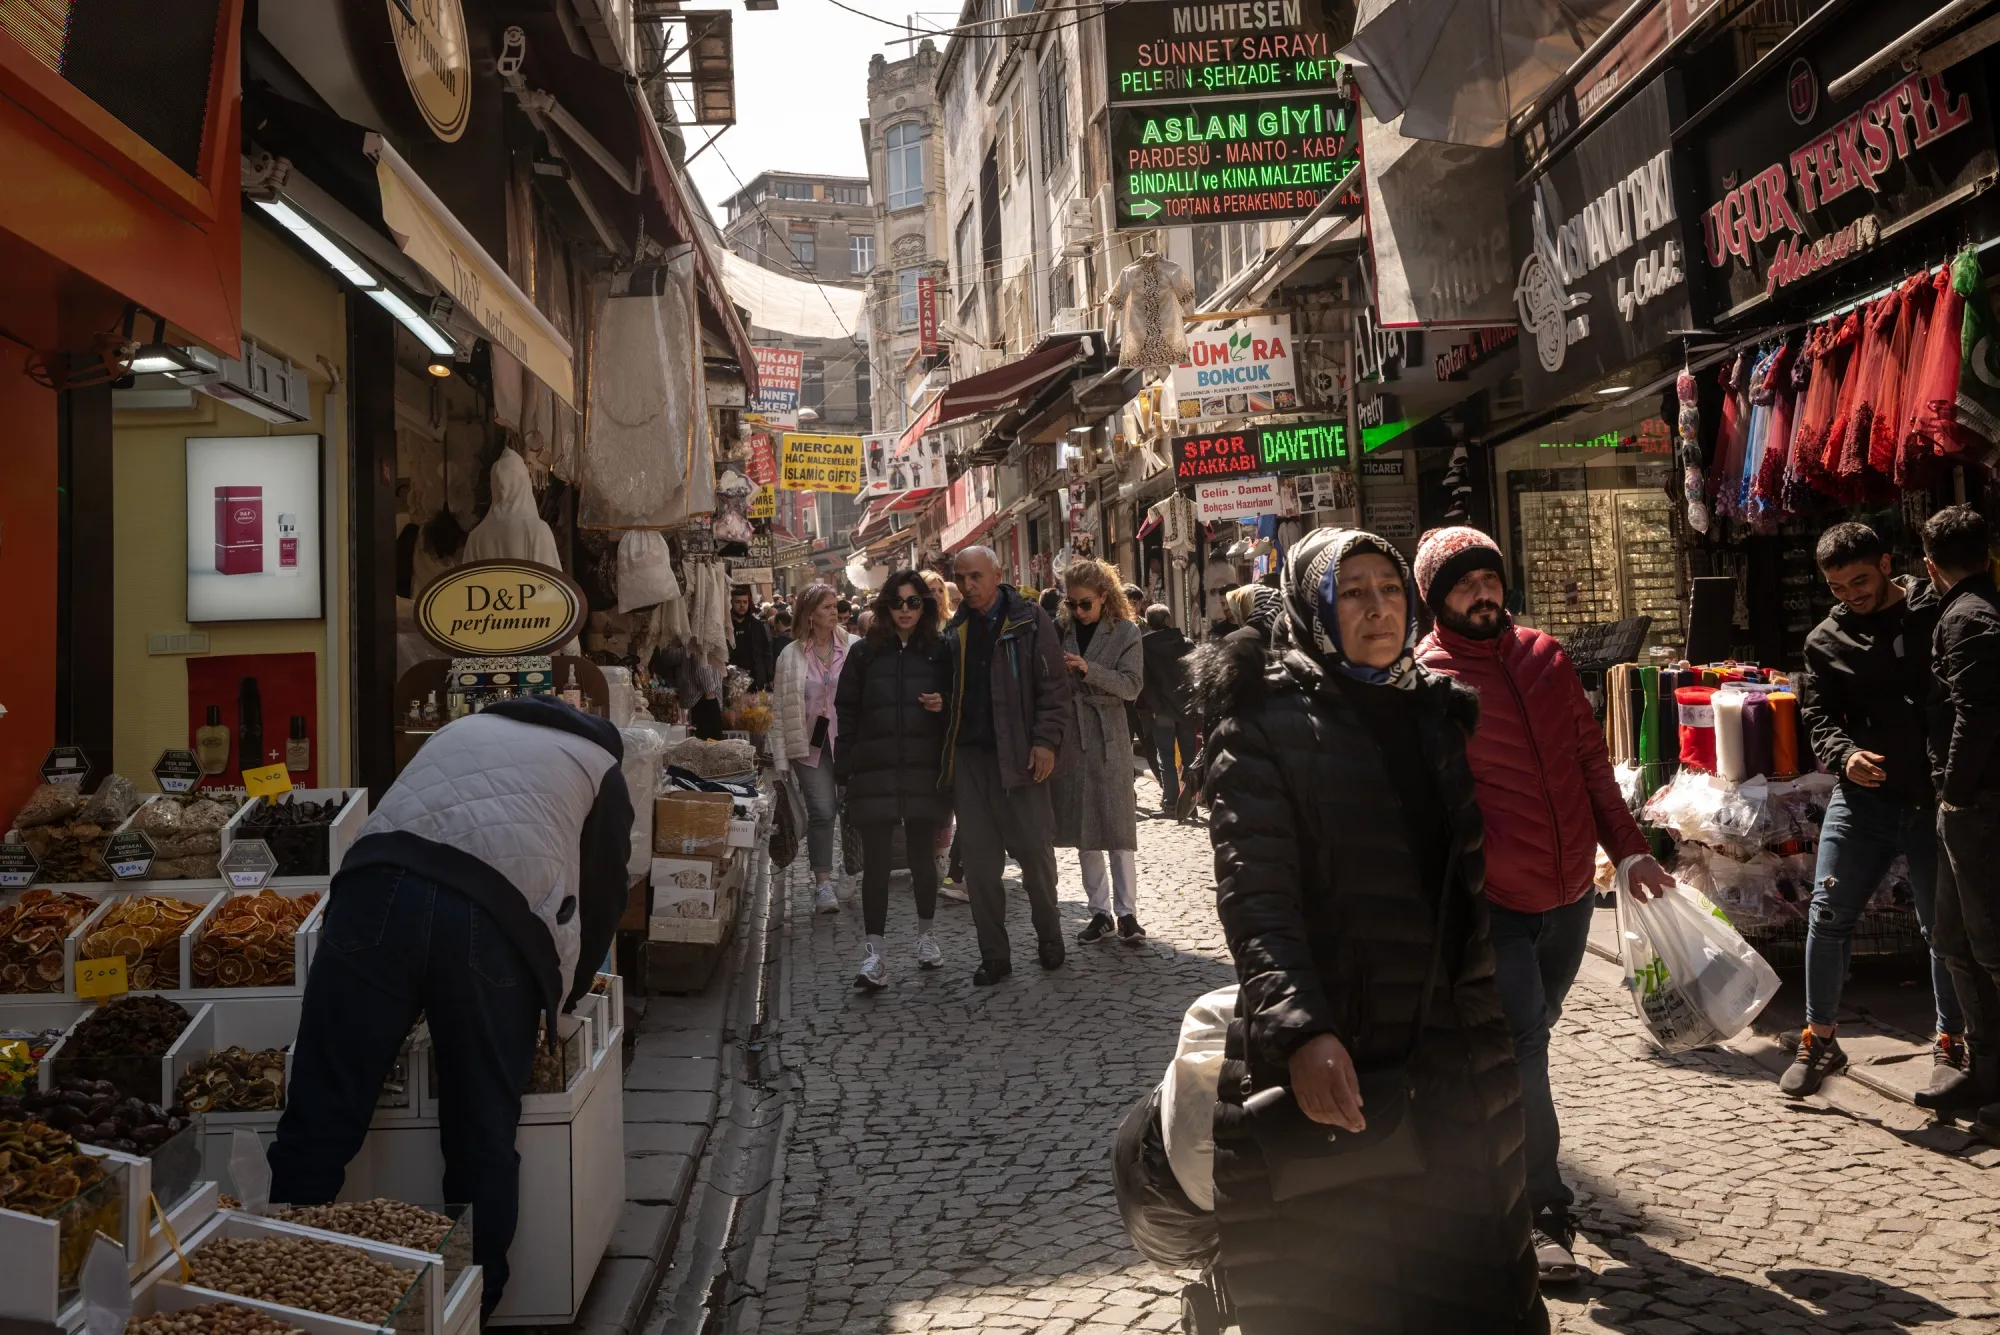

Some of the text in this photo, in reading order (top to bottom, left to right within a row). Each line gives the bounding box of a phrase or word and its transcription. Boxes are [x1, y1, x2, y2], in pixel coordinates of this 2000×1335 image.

[1173, 0, 1302, 34] MUHTEŞEM
[1138, 33, 1327, 67] SÜNNET SARAYI
[1121, 66, 1193, 93] PELERİN
[1142, 104, 1346, 144] ASLAN GİYİM
[1129, 142, 1211, 170] PARDESÜ
[1226, 139, 1288, 163] MANTO
[1130, 169, 1199, 195] BİNDALLI
[1202, 173, 1219, 190] ve
[1222, 168, 1258, 189] KINA
[1165, 195, 1211, 217] TOPTAN
[1213, 196, 1221, 213] &
[1223, 191, 1294, 213] PERAKENDE
[1701, 162, 1803, 268] UĞUR
[1557, 180, 1634, 286] OSMANLI
[1627, 150, 1678, 240] TAKI
[923, 280, 933, 338] ECZANE
[1197, 364, 1271, 387] BONCUK
[1357, 393, 1384, 430] Pretty
[791, 442, 854, 454] MERCAN
[1184, 436, 1246, 459] SPOR
[1262, 425, 1346, 464] DAVETİYE
[785, 453, 858, 466] HAC MALZEMELERİ
[1178, 455, 1257, 477] AYAKKABI
[1363, 460, 1402, 475] TİCARET
[784, 465, 858, 483] İSLAMİC GİFTS
[1202, 485, 1229, 499] Gelin
[1238, 483, 1273, 496] Damat
[1203, 498, 1274, 513] Bohçası Hazırlanır
[449, 613, 551, 636] perfumum
